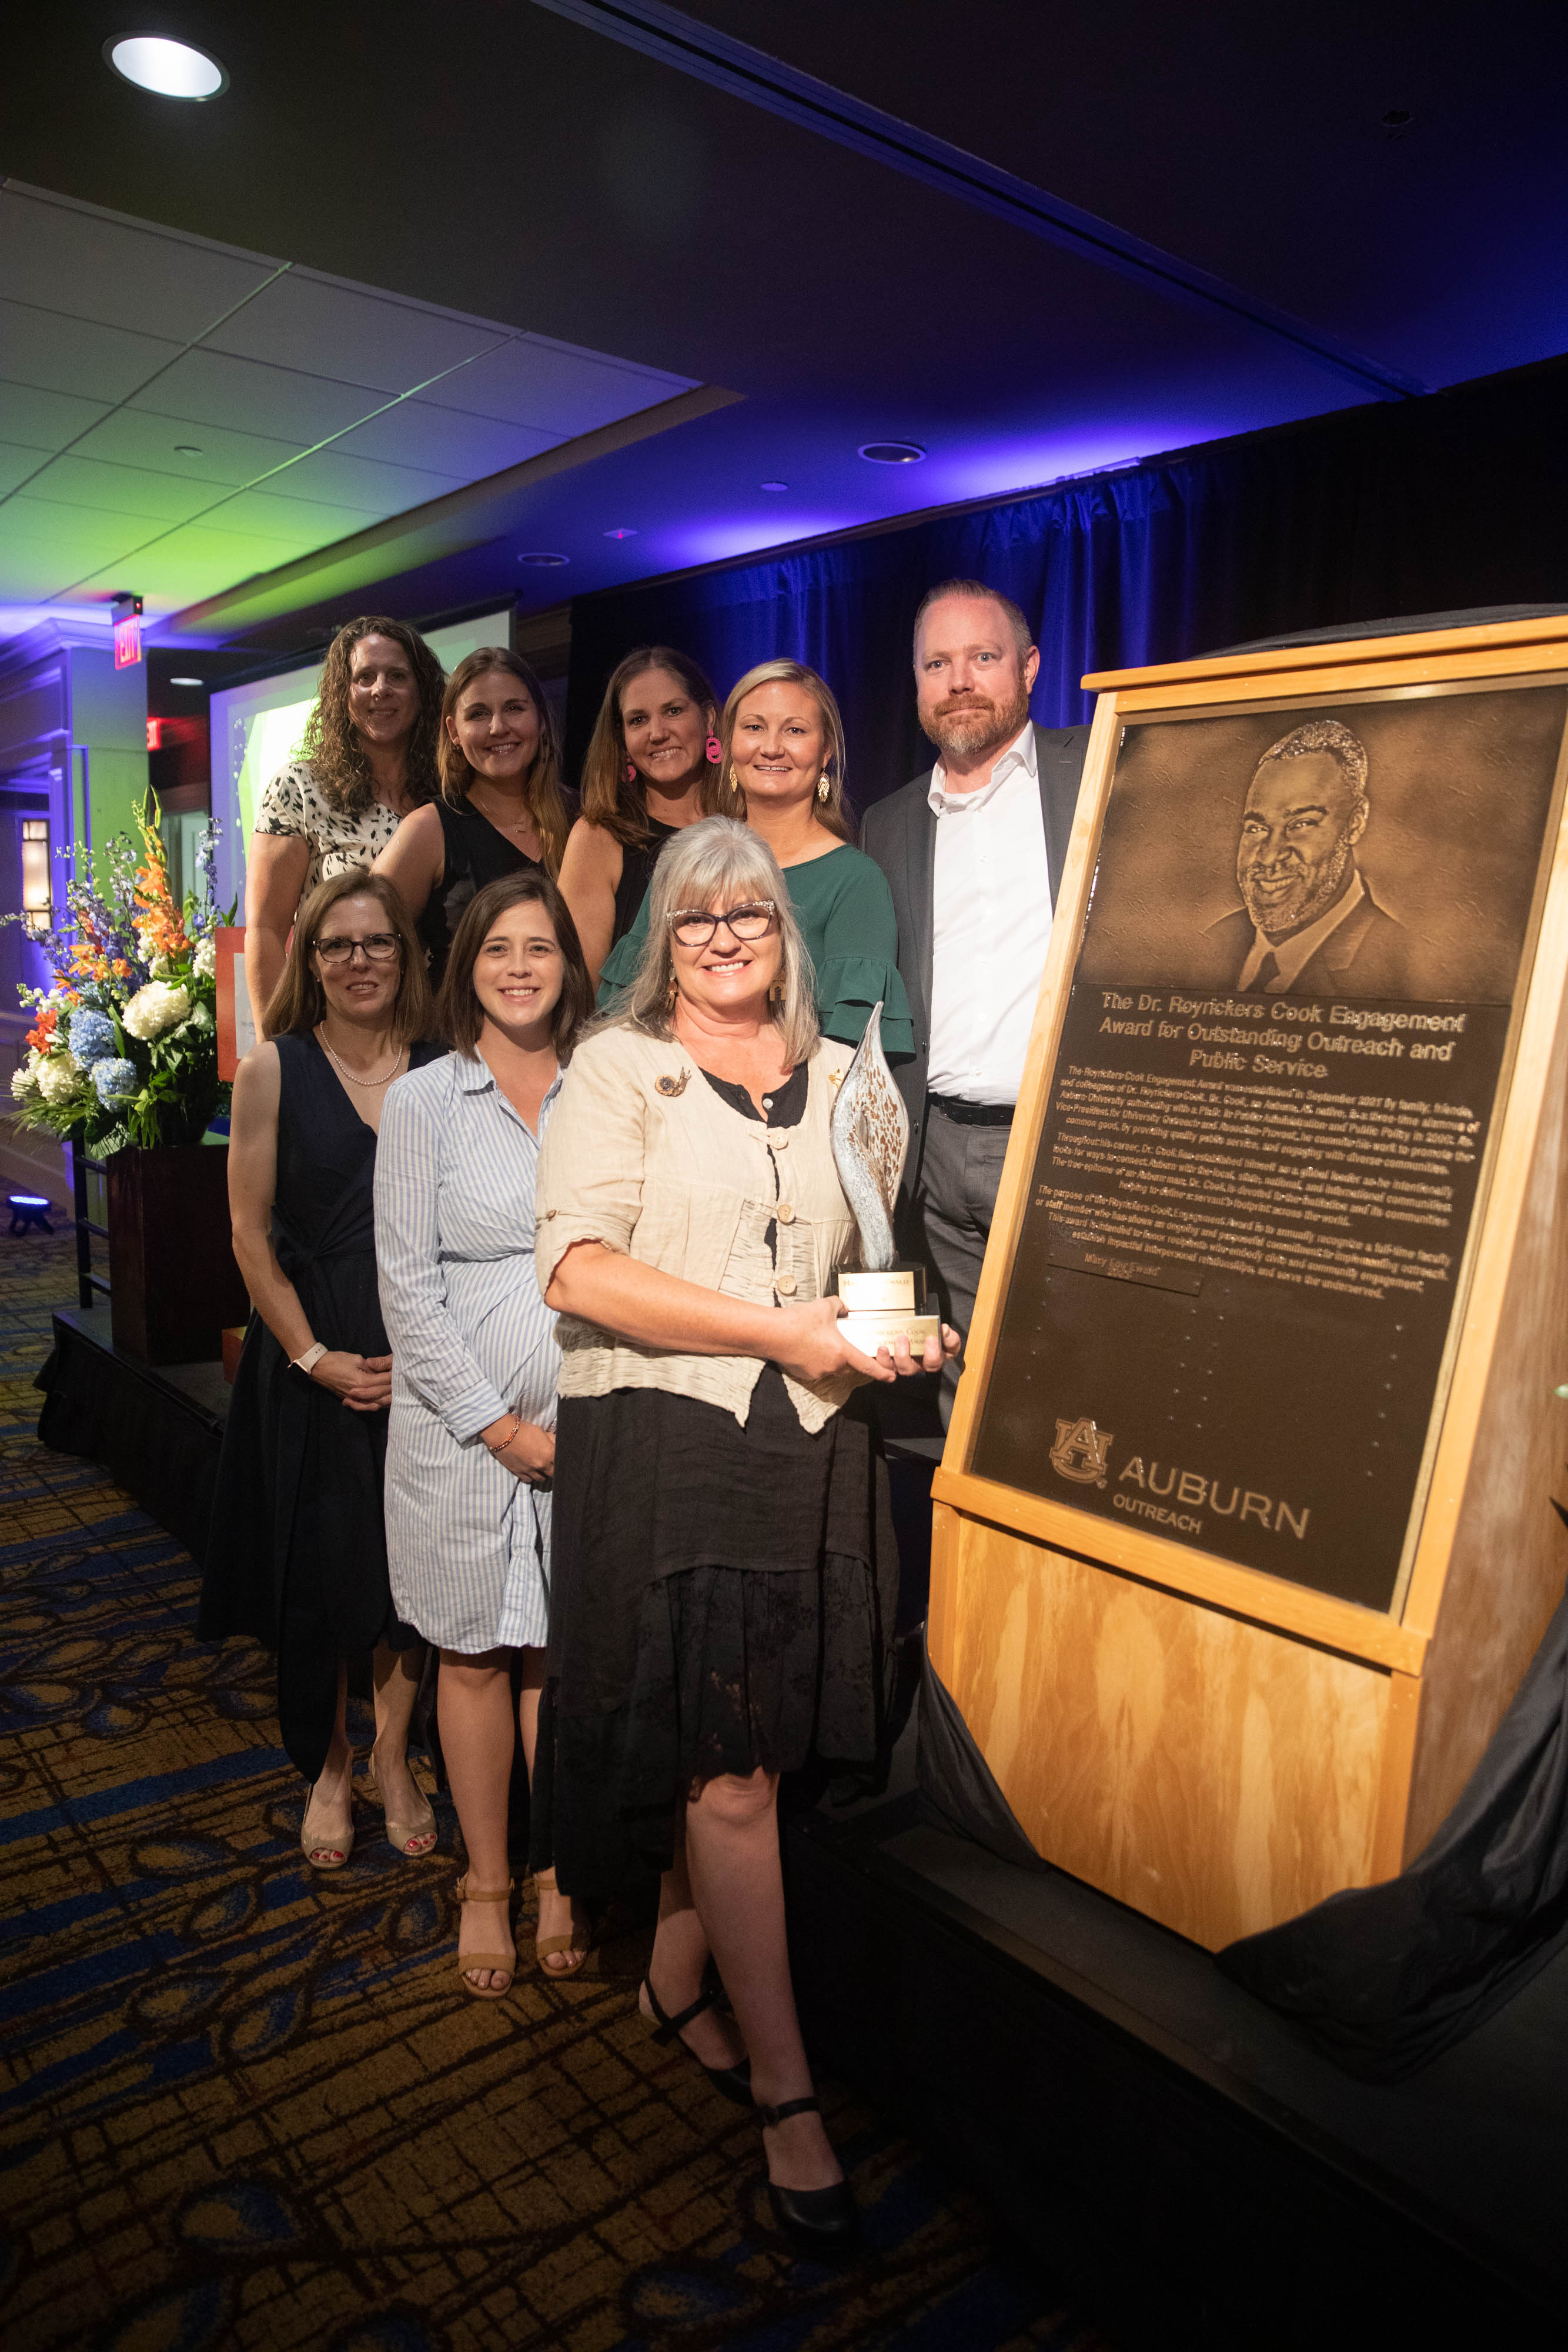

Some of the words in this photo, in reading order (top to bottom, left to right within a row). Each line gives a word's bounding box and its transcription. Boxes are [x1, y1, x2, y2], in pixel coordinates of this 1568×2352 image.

[120, 622, 135, 663] EXIT
[1102, 991, 1132, 1009] The
[1138, 994, 1161, 1011] Dr.
[1169, 996, 1263, 1018] Royrickers
[1271, 1001, 1323, 1023] Cook
[1330, 1005, 1465, 1032] Engagement
[1099, 1017, 1154, 1035] Award
[1158, 1020, 1182, 1038] for
[1188, 1023, 1300, 1052] Outstanding
[1308, 1031, 1403, 1056] Outreach
[1410, 1041, 1455, 1061] and
[1189, 1049, 1246, 1070] Public
[1252, 1054, 1327, 1078] Service
[1060, 1078, 1075, 1087] and
[1075, 1080, 1115, 1092] colleagues
[1126, 1084, 1137, 1094] Dr.
[1139, 1086, 1181, 1098] Royrickers
[1069, 1065, 1082, 1075] The
[1084, 1067, 1123, 1079] Royrickers
[1124, 1071, 1144, 1081] Cook
[1146, 1074, 1196, 1087] Engagement
[1196, 1079, 1223, 1090] Award
[1306, 1090, 1356, 1104] September
[1056, 1101, 1071, 1111] Vice
[1072, 1104, 1108, 1115] President
[1109, 1108, 1121, 1117] for
[1122, 1110, 1159, 1124] University
[1162, 1115, 1199, 1127] Outreach
[1201, 1121, 1218, 1130] and
[1059, 1090, 1085, 1100] Auburn
[1088, 1093, 1124, 1107] University
[1126, 1098, 1171, 1112] culminating
[1172, 1103, 1189, 1112] with
[1065, 1117, 1096, 1127] common
[1132, 1125, 1169, 1138] providing
[1170, 1130, 1196, 1142] quality
[1052, 1144, 1072, 1154] looks
[1074, 1147, 1085, 1156] for
[1086, 1151, 1105, 1161] ways
[1147, 1158, 1177, 1170] Auburn
[1178, 1163, 1196, 1172] with
[1058, 1132, 1098, 1145] Throughout
[1099, 1138, 1111, 1148] his
[1141, 1144, 1154, 1153] Dr.
[1155, 1145, 1177, 1157] Cook
[1195, 1153, 1243, 1166] established
[1052, 1156, 1066, 1166] The
[1067, 1159, 1082, 1168] true
[1084, 1162, 1114, 1174] epitome
[1136, 1170, 1165, 1181] Auburn
[1039, 1185, 1052, 1194] The
[1053, 1189, 1083, 1200] purpose
[1094, 1194, 1106, 1204] the
[1108, 1197, 1149, 1212] Royrickers
[1151, 1204, 1172, 1217] Cook
[1119, 1180, 1148, 1194] helping
[1045, 1200, 1062, 1209] staff
[1062, 1204, 1092, 1214] member
[1094, 1208, 1111, 1218] who
[1111, 1211, 1126, 1221] has
[1166, 1222, 1200, 1236] ongoing
[1200, 1228, 1218, 1237] and
[1048, 1211, 1064, 1222] This
[1065, 1217, 1088, 1227] award
[1098, 1221, 1132, 1235] intended
[1072, 1231, 1105, 1242] establish
[1107, 1236, 1143, 1251] impactful
[1084, 1252, 1108, 1267] Mary
[1118, 1456, 1309, 1539] AUBURN
[1113, 1493, 1202, 1535] OUTREACH
